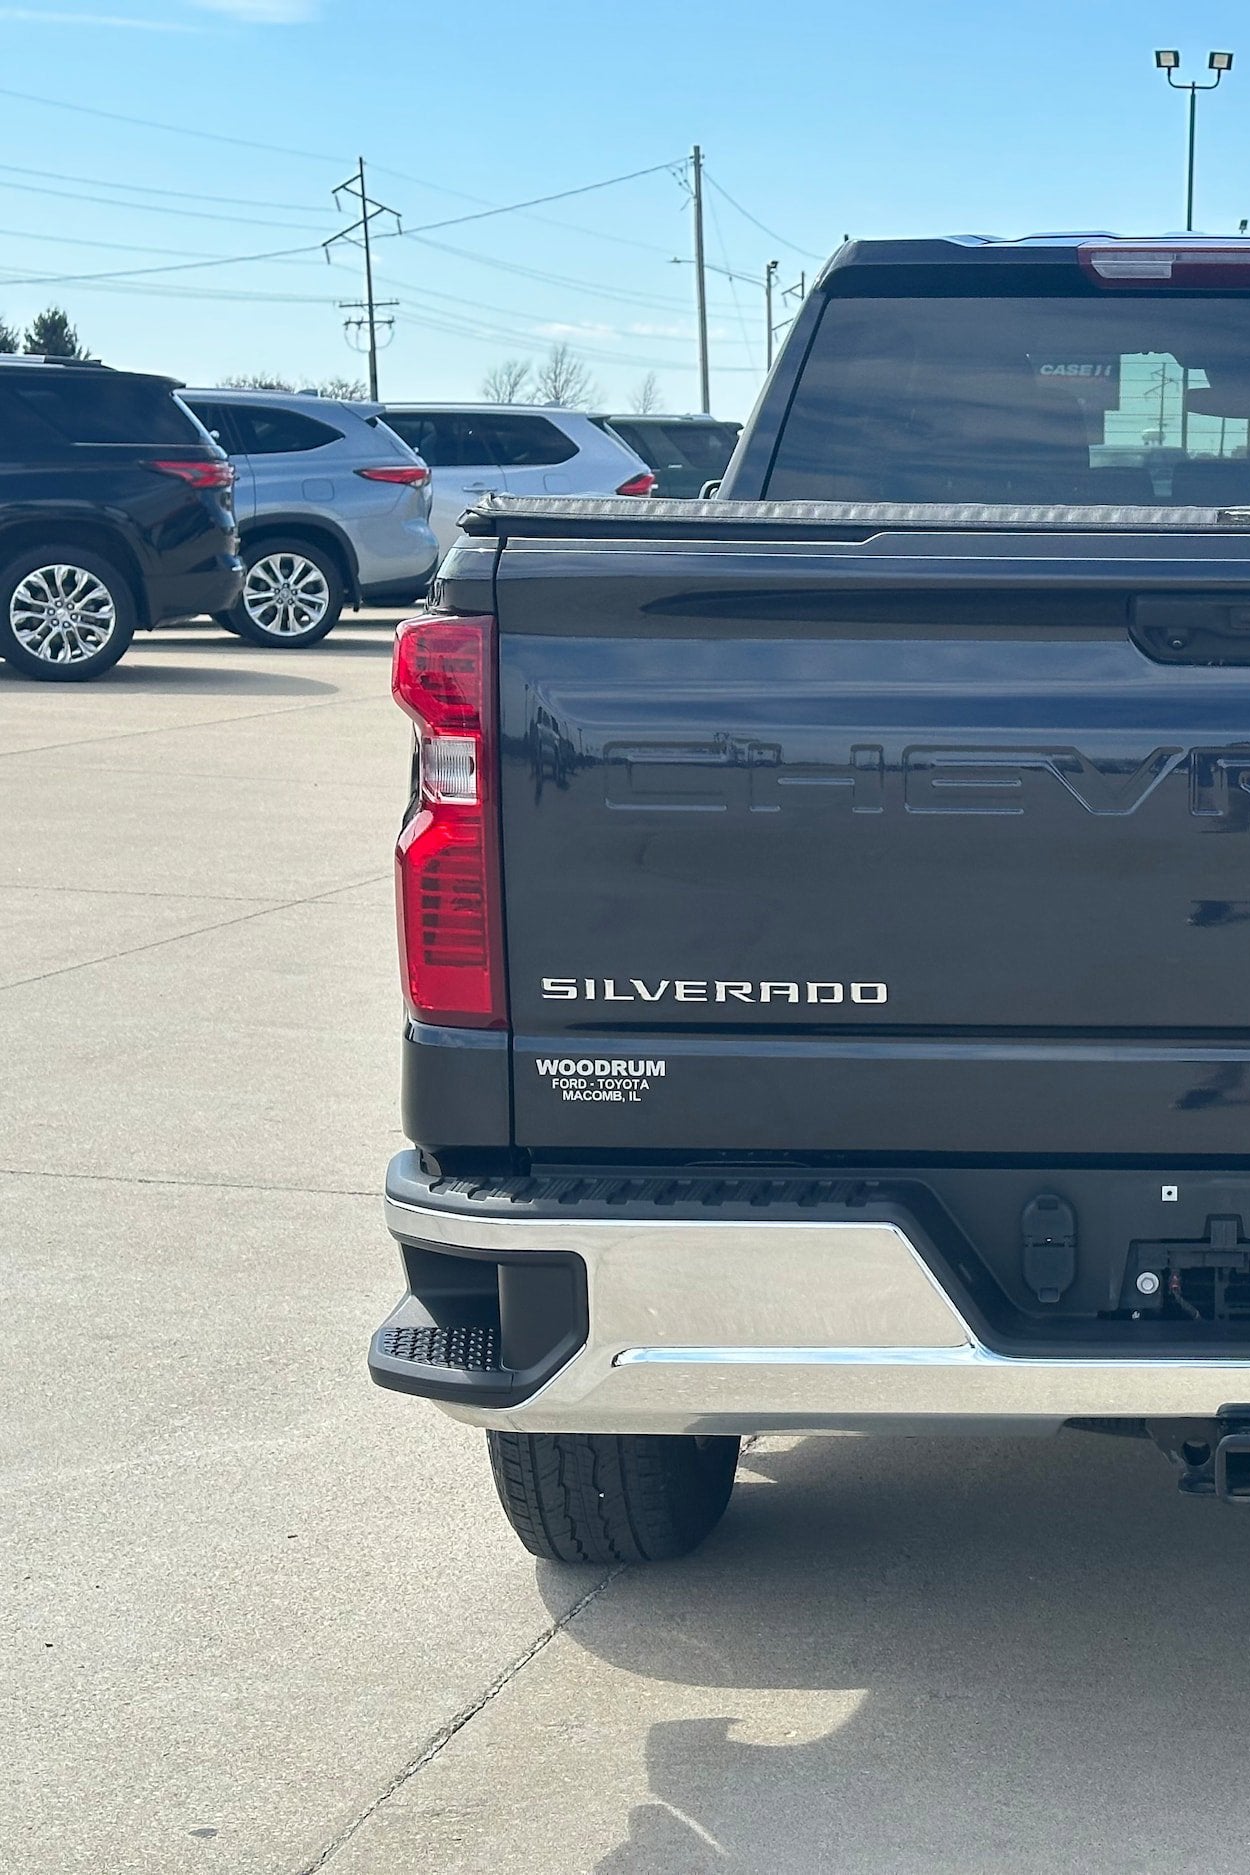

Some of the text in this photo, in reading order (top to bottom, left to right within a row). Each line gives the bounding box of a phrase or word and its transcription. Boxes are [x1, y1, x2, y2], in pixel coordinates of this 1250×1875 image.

[1040, 364, 1093, 377] CASE
[541, 977, 889, 1004] SILVERADO
[535, 1058, 667, 1077] WOODRUM
[552, 1078, 587, 1090] FORD
[597, 1078, 651, 1091] TOYOTA
[562, 1090, 643, 1103] MACOMB, IL
